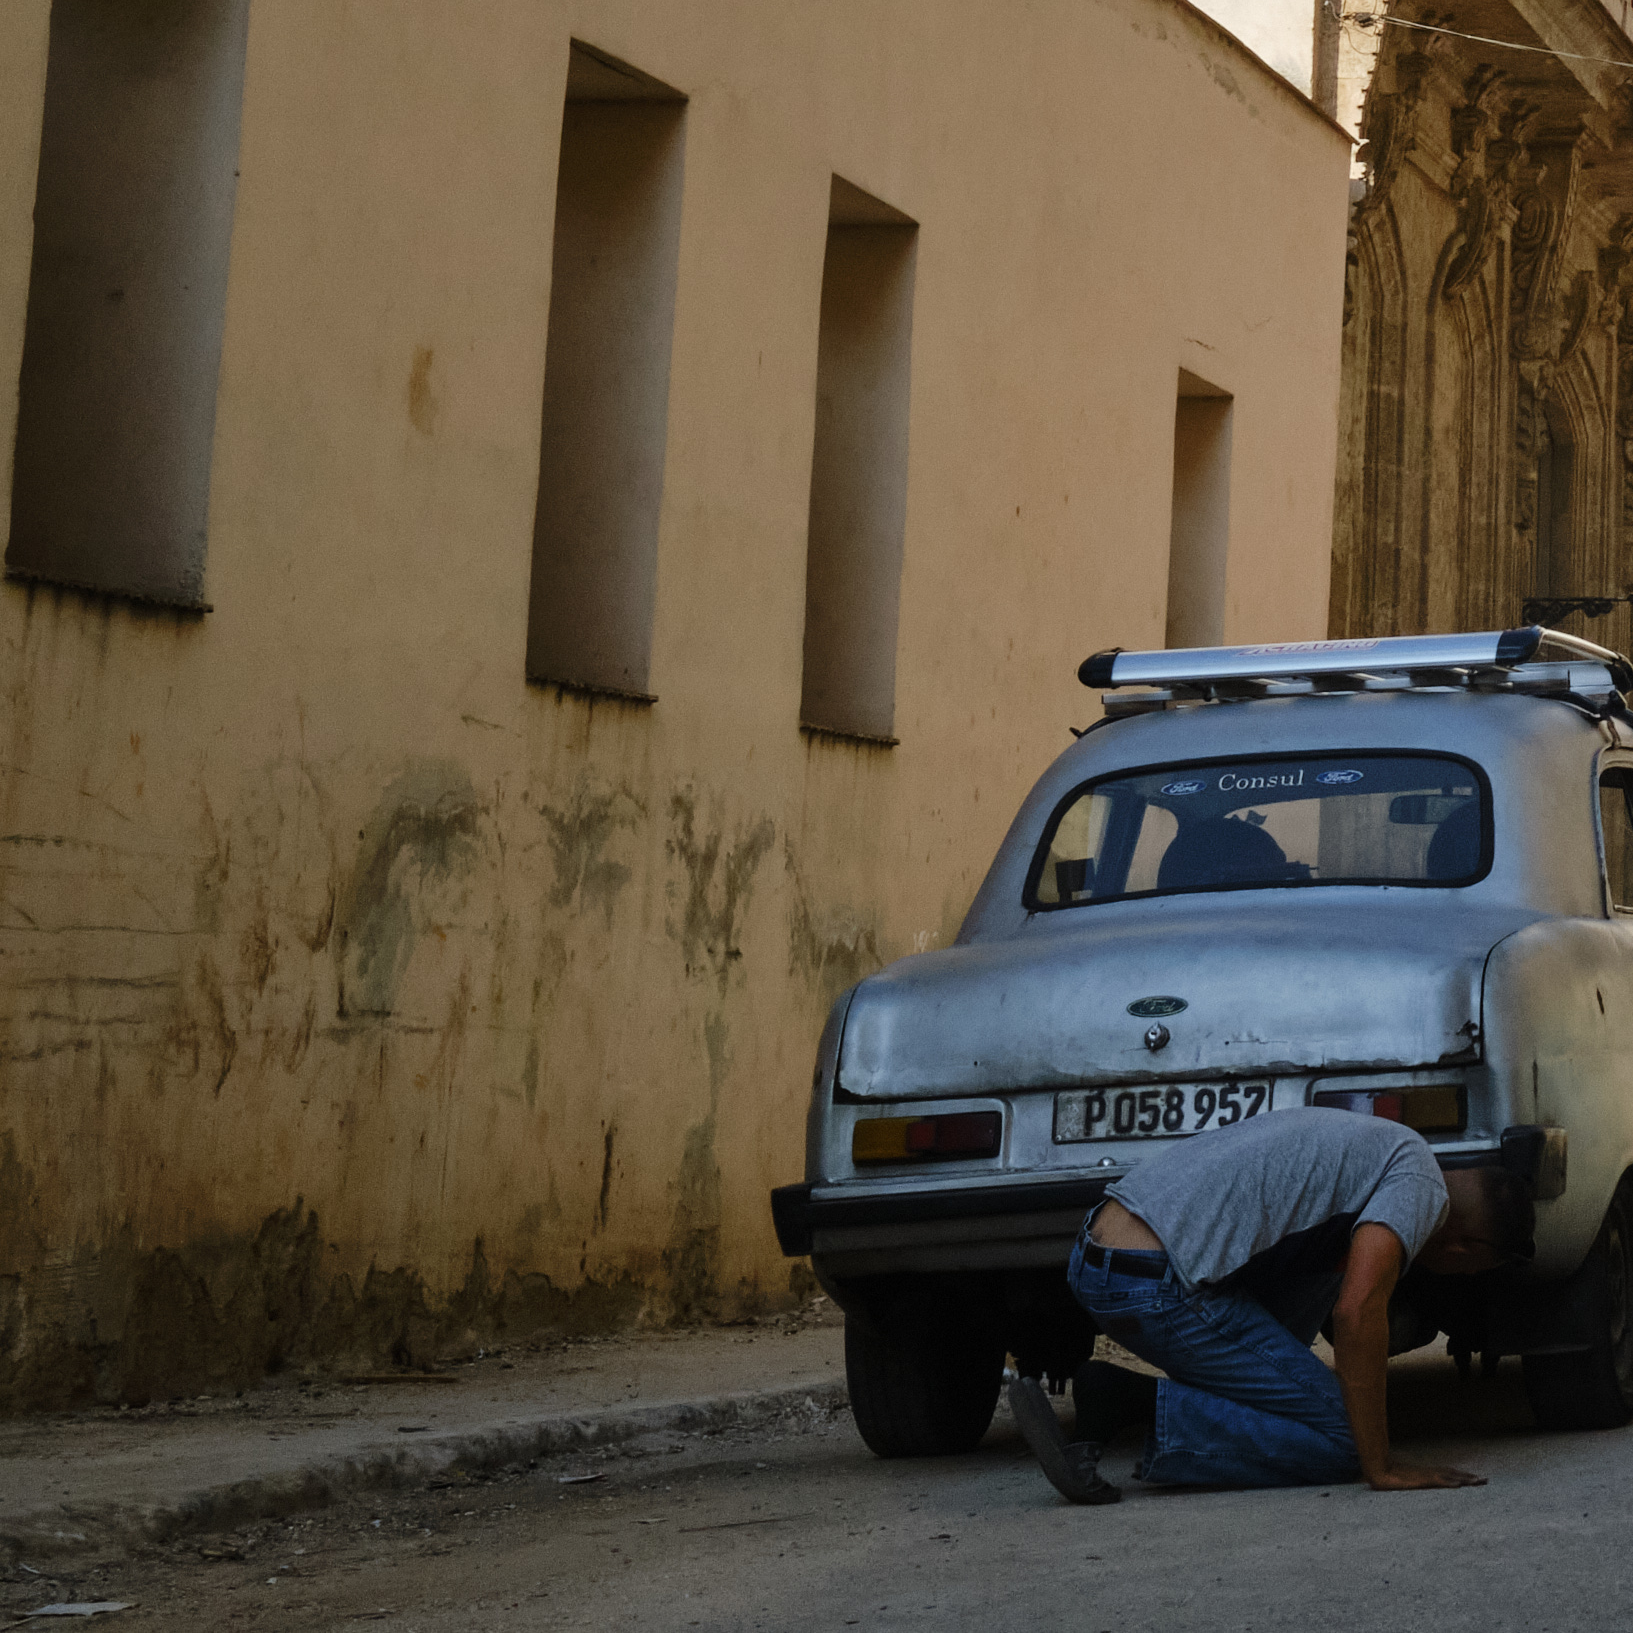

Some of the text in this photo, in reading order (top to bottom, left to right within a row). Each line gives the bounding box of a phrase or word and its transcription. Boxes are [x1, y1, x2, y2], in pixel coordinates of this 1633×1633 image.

[1218, 769, 1304, 791] Consul
[1322, 770, 1355, 783] Ford
[1168, 781, 1201, 794] Ford
[1084, 1085, 1266, 1137] P 058 957
